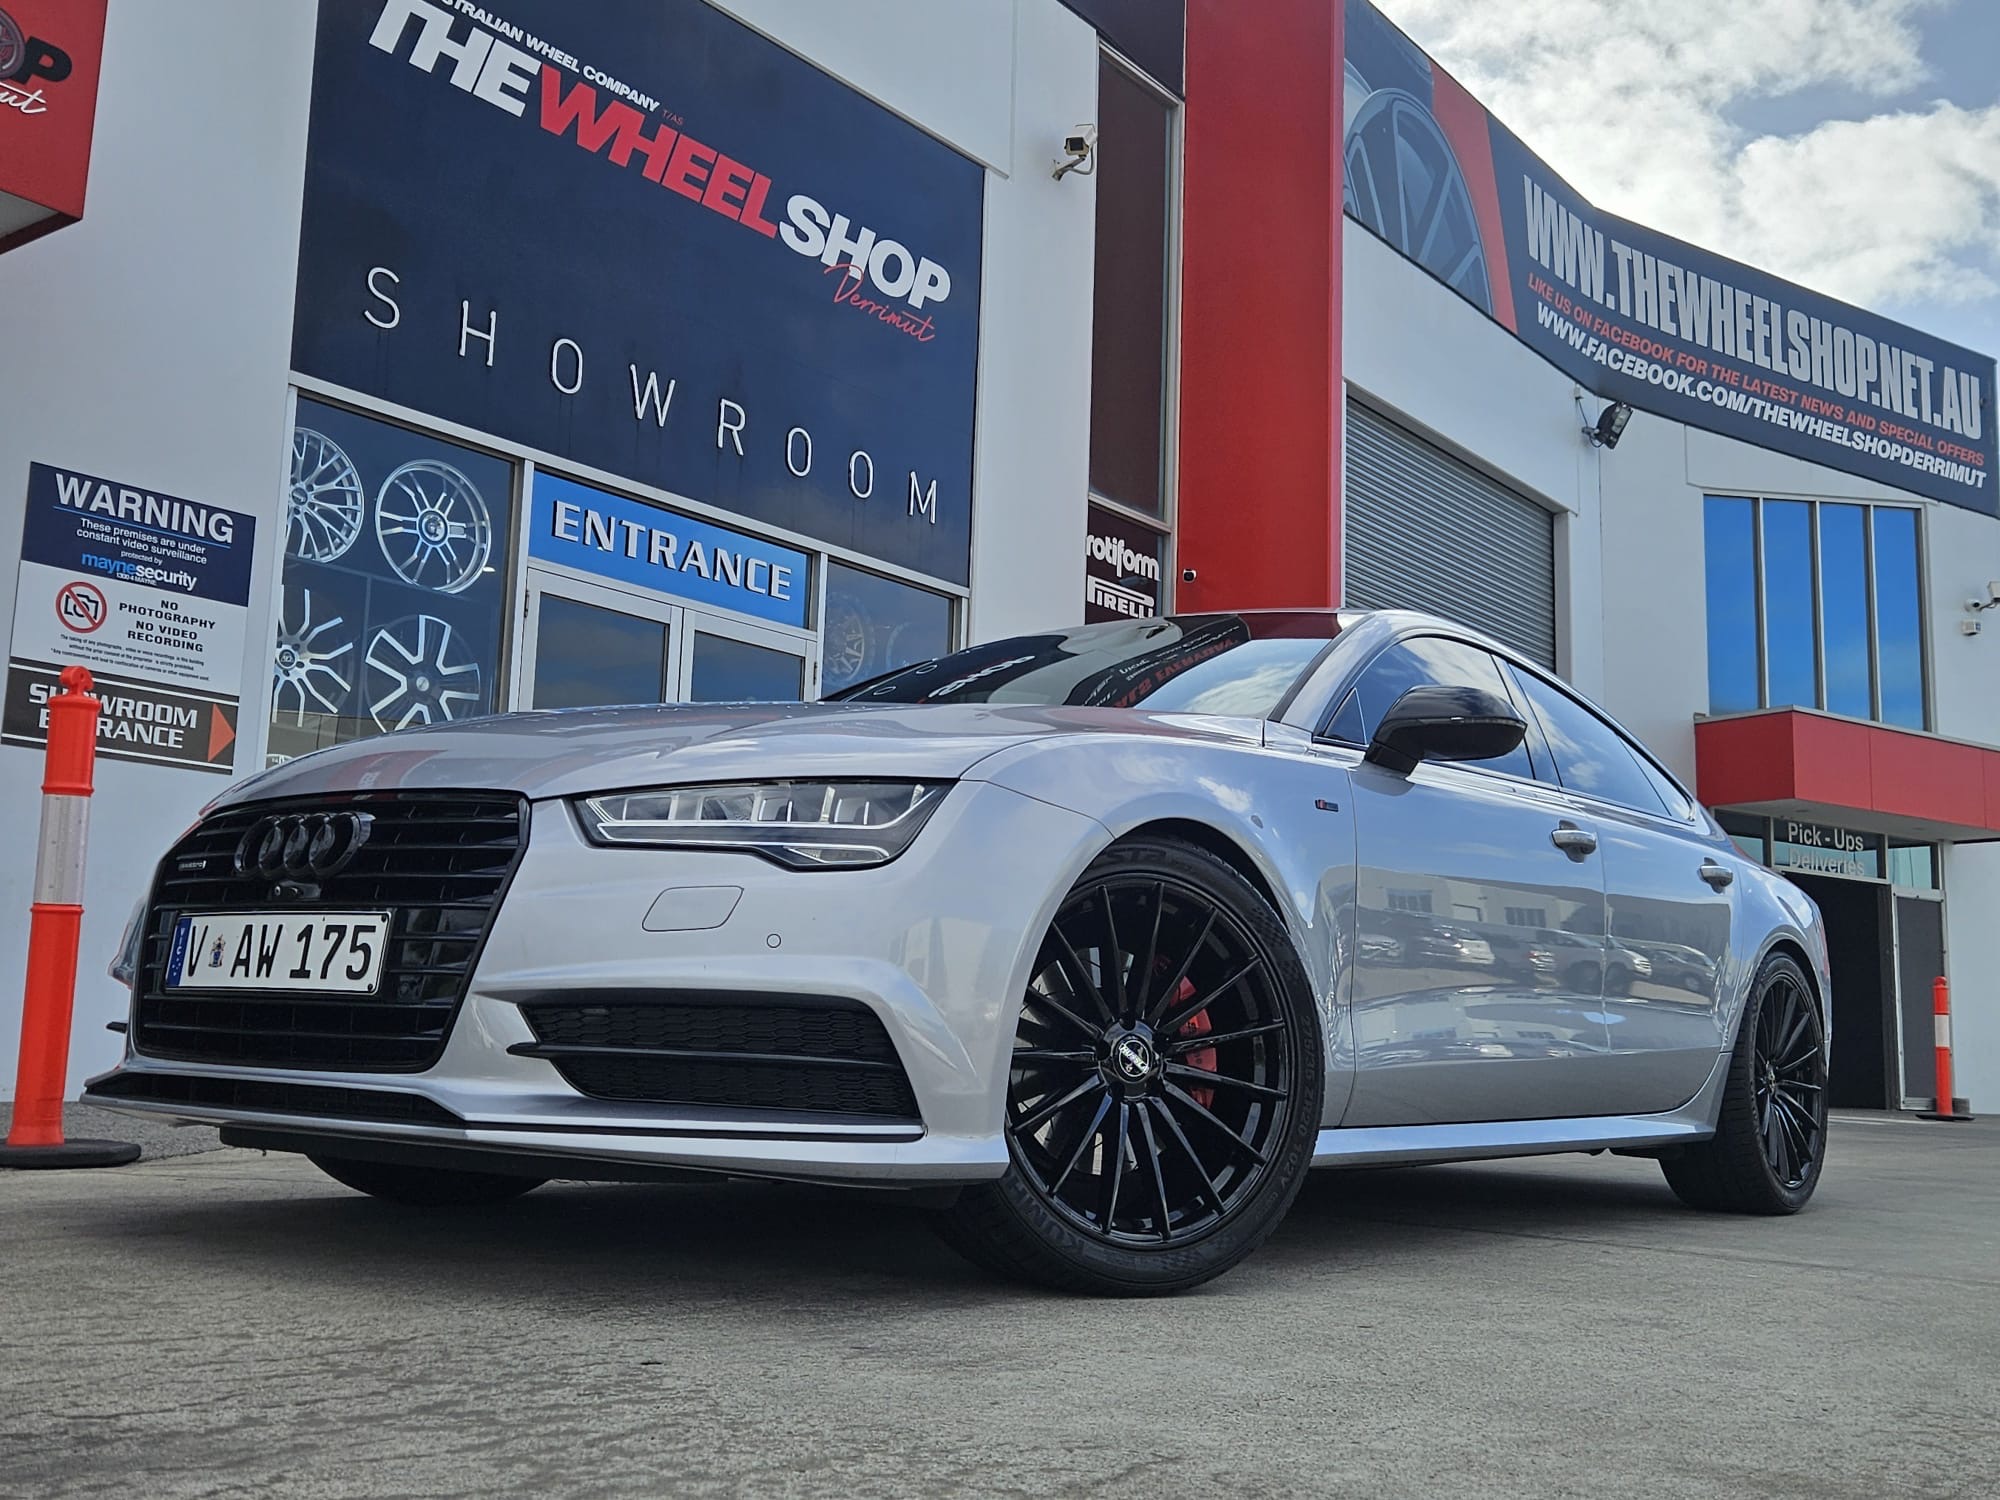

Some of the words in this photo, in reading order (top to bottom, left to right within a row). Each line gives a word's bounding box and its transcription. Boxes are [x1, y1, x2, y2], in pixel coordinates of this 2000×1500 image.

[525, 33, 579, 73] WHEEL
[583, 65, 660, 111] COMPANY
[369, 0, 542, 117] THE
[540, 64, 777, 238] WHEEL
[779, 195, 951, 309] SHOP
[824, 263, 935, 342] Derrimut
[1524, 174, 1982, 441] WWW.THEWHEELSHOP.NET.AU
[1528, 273, 1554, 302] LIKE
[1555, 292, 1572, 315] US
[1574, 306, 1593, 329] ON
[1593, 318, 1675, 364] FACEBOOK
[1676, 351, 1708, 375] FOR
[1711, 364, 1740, 386] THE
[1742, 375, 1799, 405] LATEST
[1800, 395, 1844, 420] NEWS
[1846, 410, 1876, 431] AND
[1879, 421, 1935, 450] SPECIAL
[1937, 440, 1985, 466] OFFERS
[364, 266, 937, 525] SHOWROOM
[1537, 301, 1987, 489] WWW.FACEBOOK.COM/THEWHEELSHOPDERRIMUT
[55, 473, 234, 544] WARNING
[76, 529, 119, 545] constant
[122, 538, 149, 551] video
[151, 545, 207, 564] surveillance
[80, 518, 111, 533] These
[113, 527, 158, 543] premises
[160, 537, 176, 548] are
[178, 541, 206, 555] under
[120, 550, 153, 563] protected
[154, 555, 163, 566] by
[553, 500, 792, 601] ENTRANCE
[1086, 534, 1161, 581] rotiform
[119, 602, 216, 630] PHOTOGRAPHY
[160, 600, 178, 611] NO
[1086, 574, 1155, 619] PIRELLI
[127, 630, 204, 652] RECORDING
[135, 620, 154, 632] NO
[158, 625, 198, 640] VIDEO
[29, 683, 198, 728] SWROOM
[38, 708, 185, 748] ERANCE
[1788, 822, 1822, 846] Pick
[1834, 828, 1864, 852] Ups
[1789, 849, 1865, 875] Deliveries
[187, 925, 209, 977] V
[230, 924, 284, 978] AW
[289, 924, 377, 980] 175
[1004, 1170, 1086, 1256] KUMH
